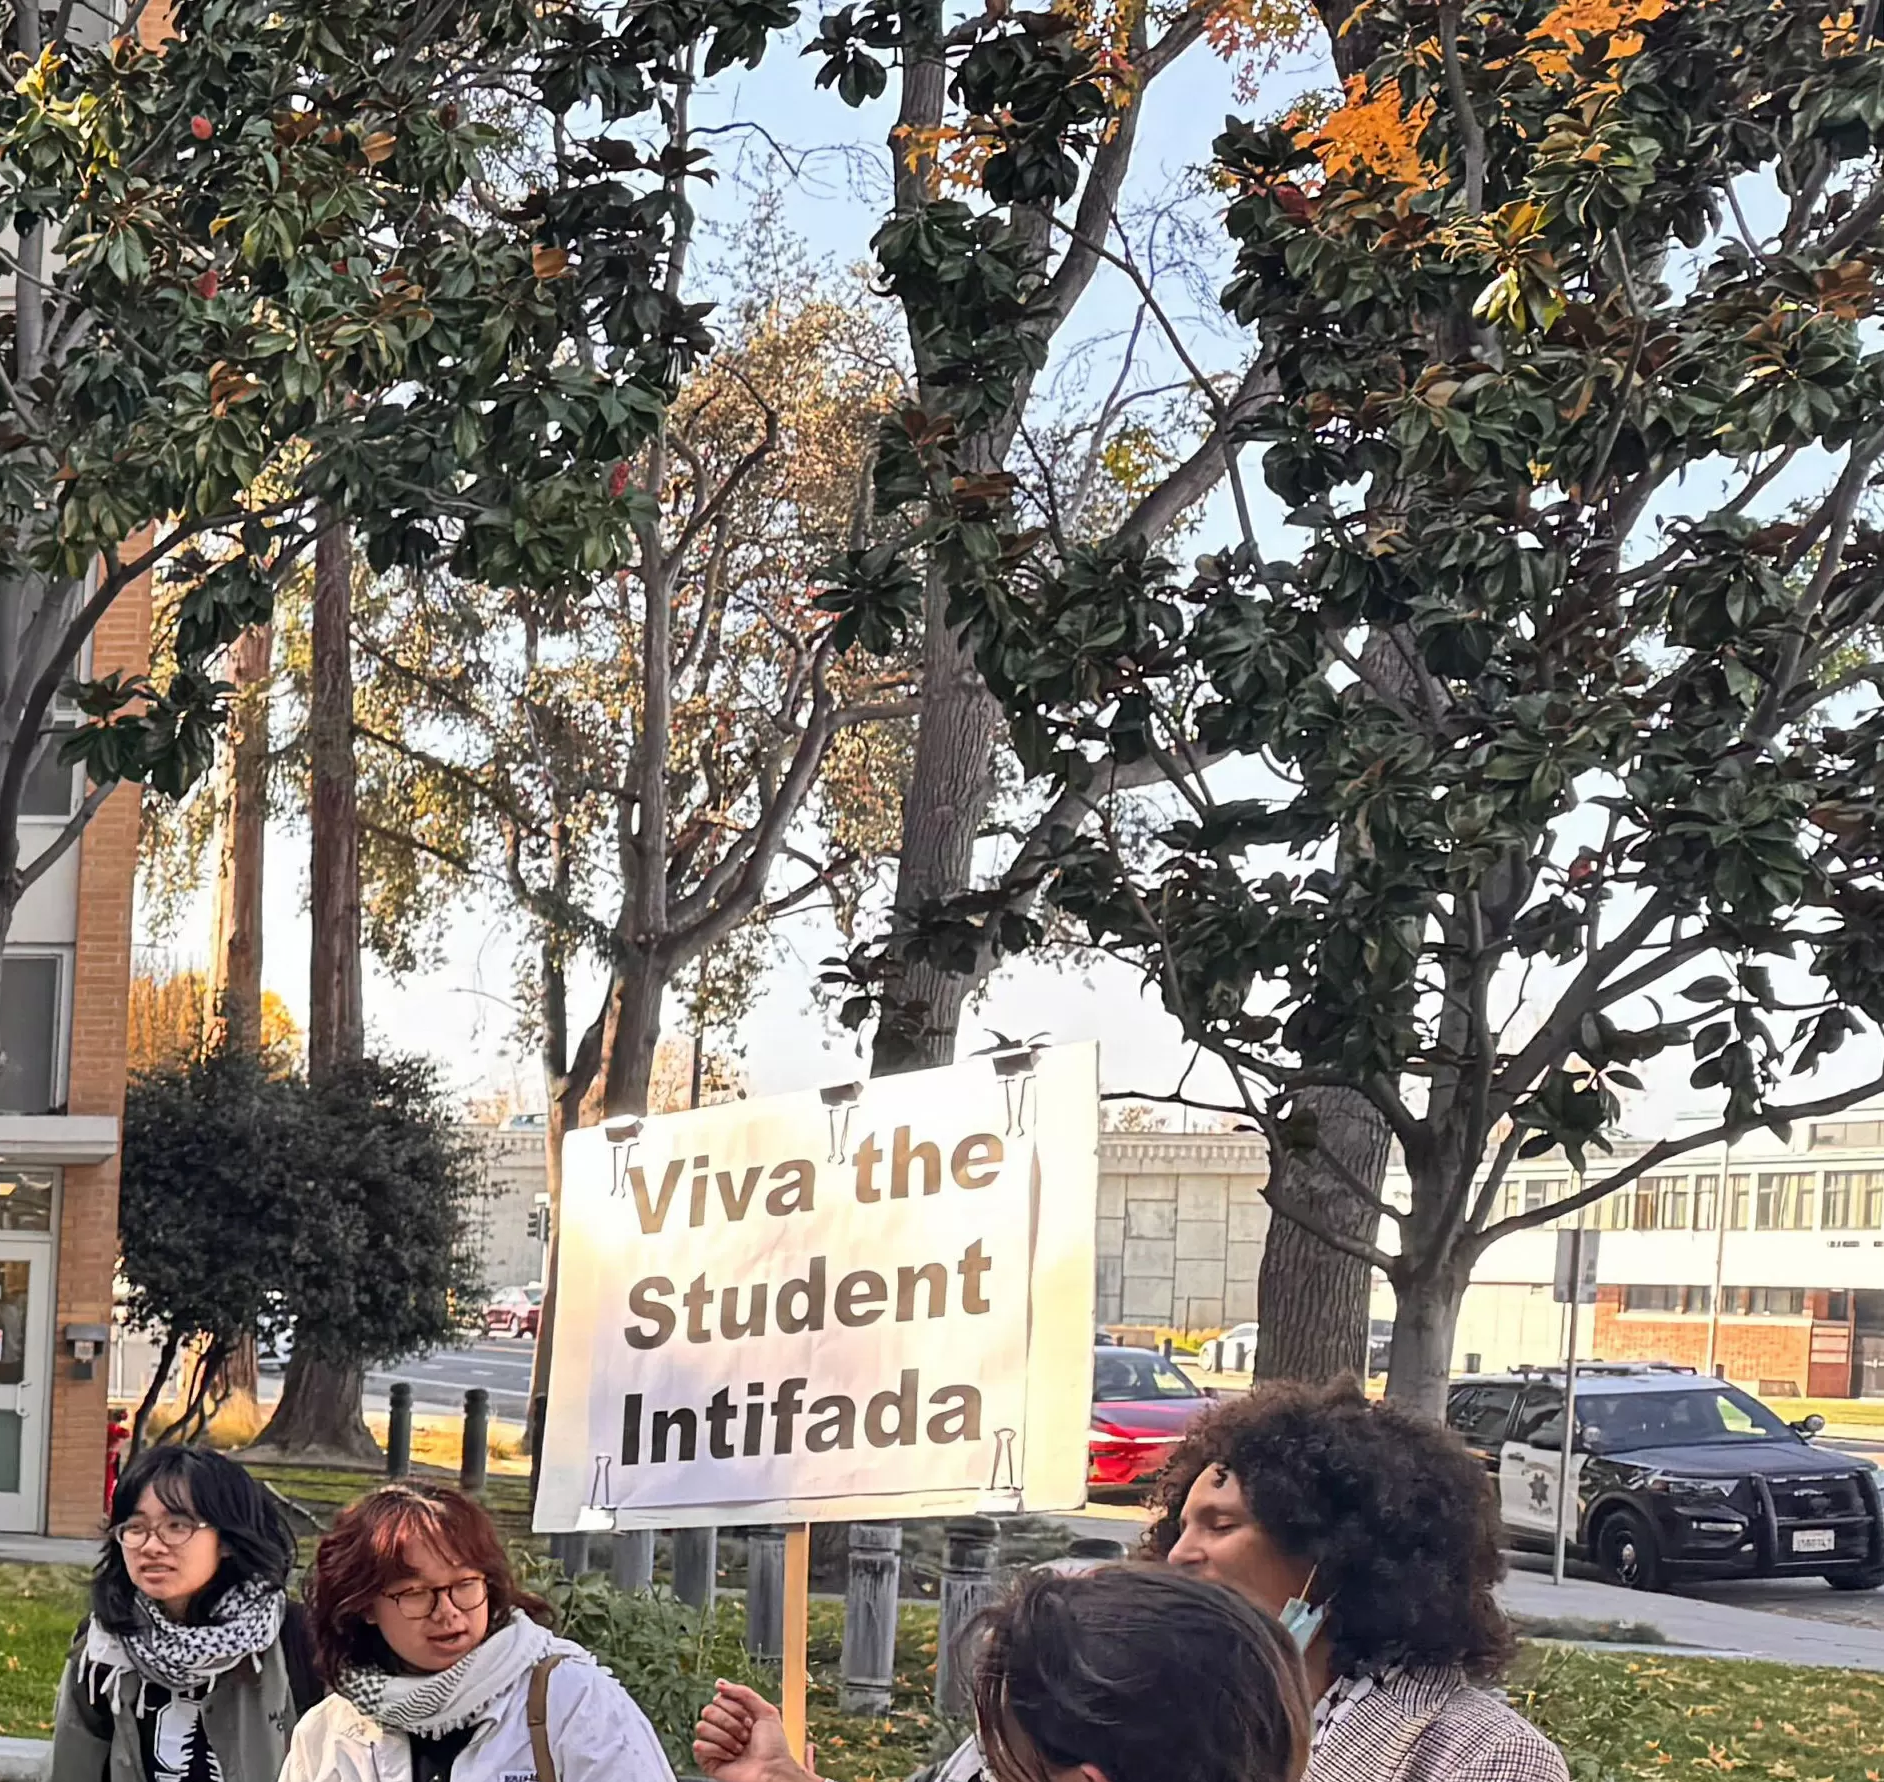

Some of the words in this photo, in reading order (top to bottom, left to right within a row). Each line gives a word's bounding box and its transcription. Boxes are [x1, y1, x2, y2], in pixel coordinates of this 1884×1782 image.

[627, 1154, 816, 1235] Viva
[852, 1125, 1005, 1204] the
[624, 1238, 992, 1350] Student
[621, 1368, 983, 1467] Intifada
